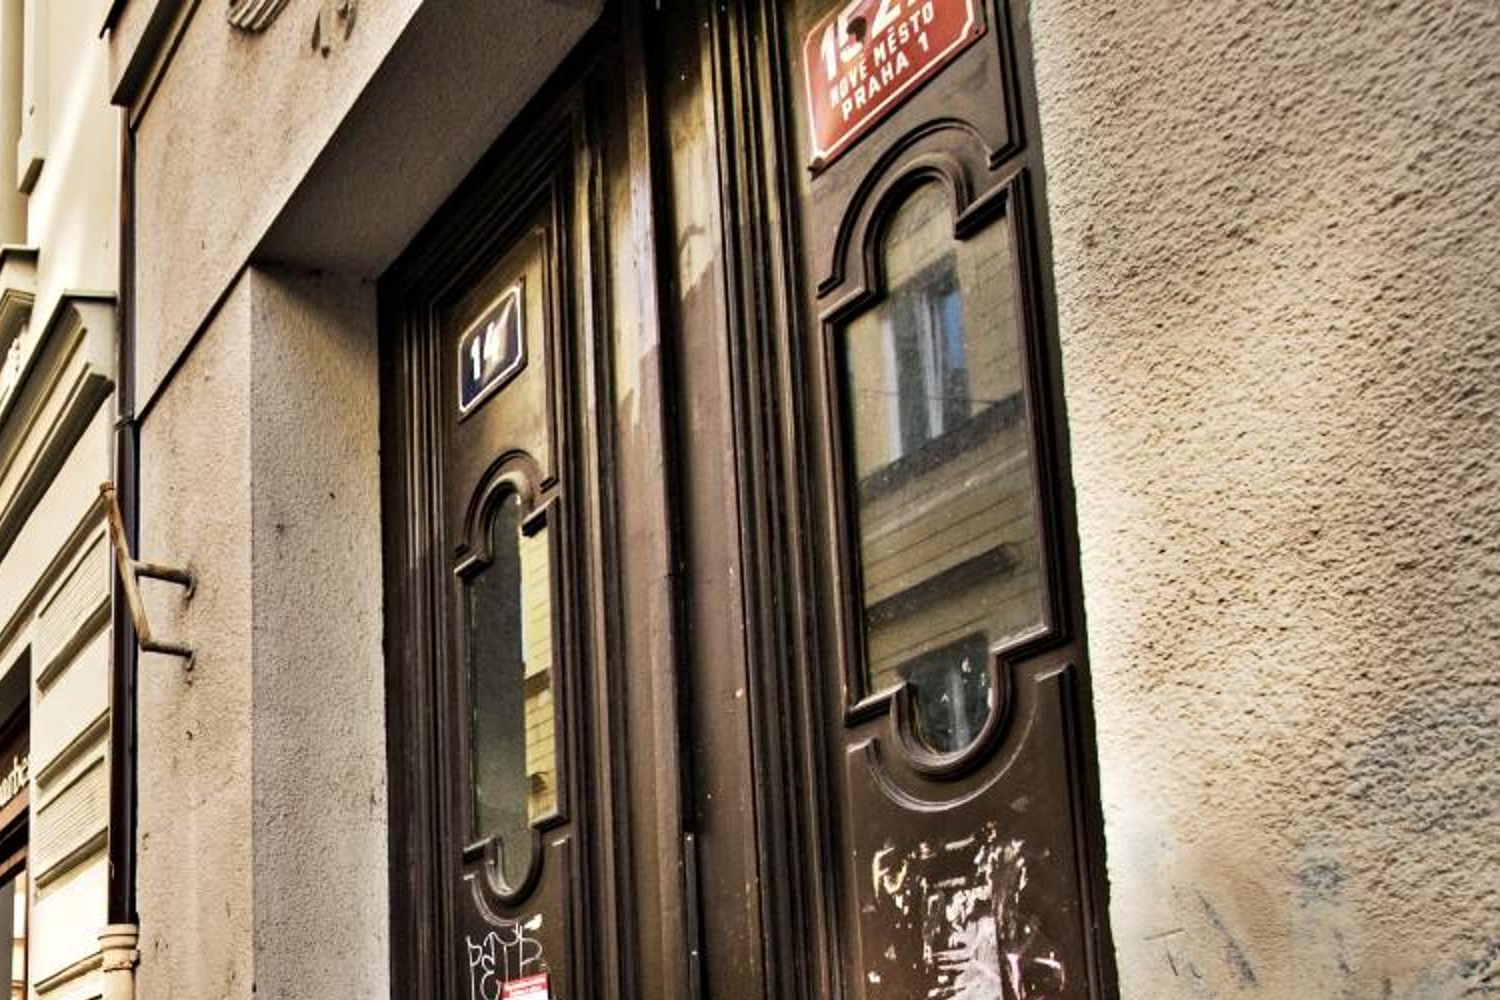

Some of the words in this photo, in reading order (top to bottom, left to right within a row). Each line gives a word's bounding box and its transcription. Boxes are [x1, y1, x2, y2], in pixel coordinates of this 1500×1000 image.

[830, 53, 868, 109] NOVÉ
[874, 1, 934, 67] MĚSTO
[841, 51, 910, 121] PRAHA
[918, 31, 929, 52] 1
